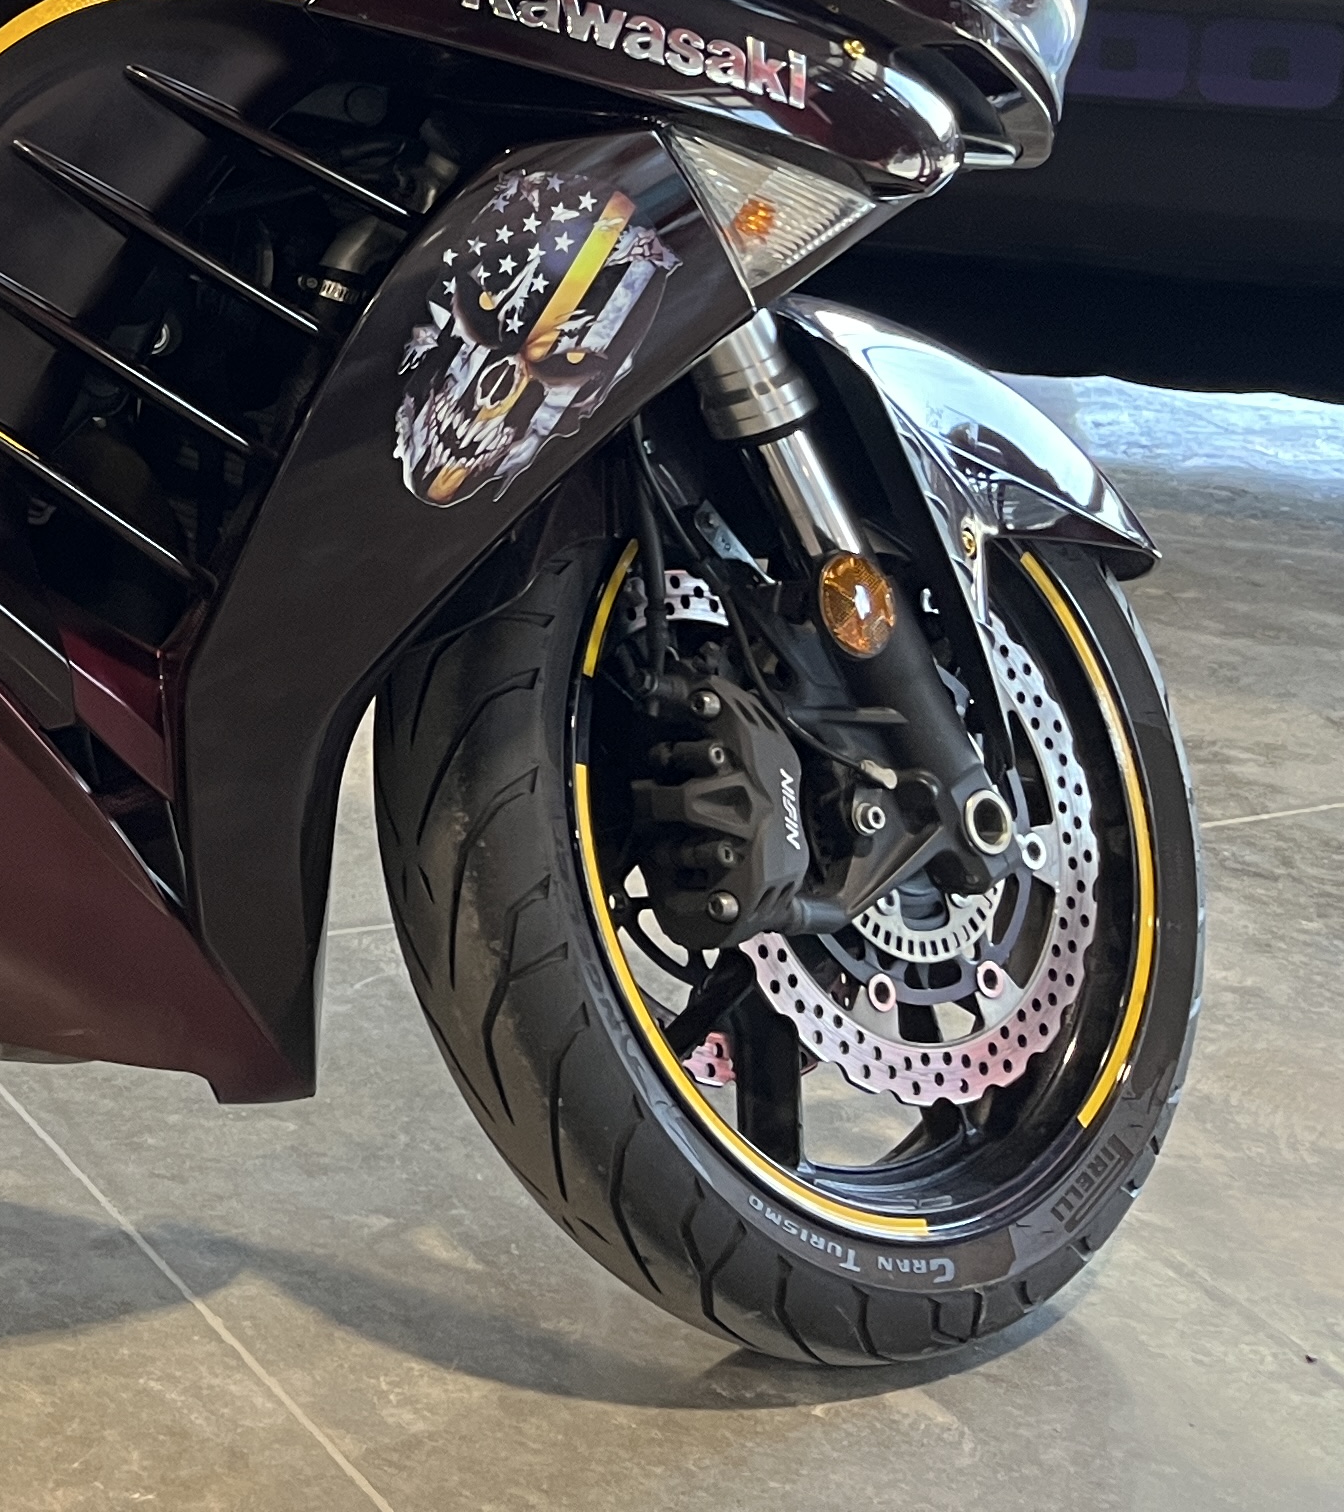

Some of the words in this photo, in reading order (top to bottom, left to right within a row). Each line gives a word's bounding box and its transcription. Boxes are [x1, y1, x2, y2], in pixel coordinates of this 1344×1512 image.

[779, 768, 801, 850] NISSIN
[1049, 1133, 1135, 1234] PIRELLI
[748, 1193, 861, 1272] TURISMO
[878, 1255, 955, 1284] GRAN
